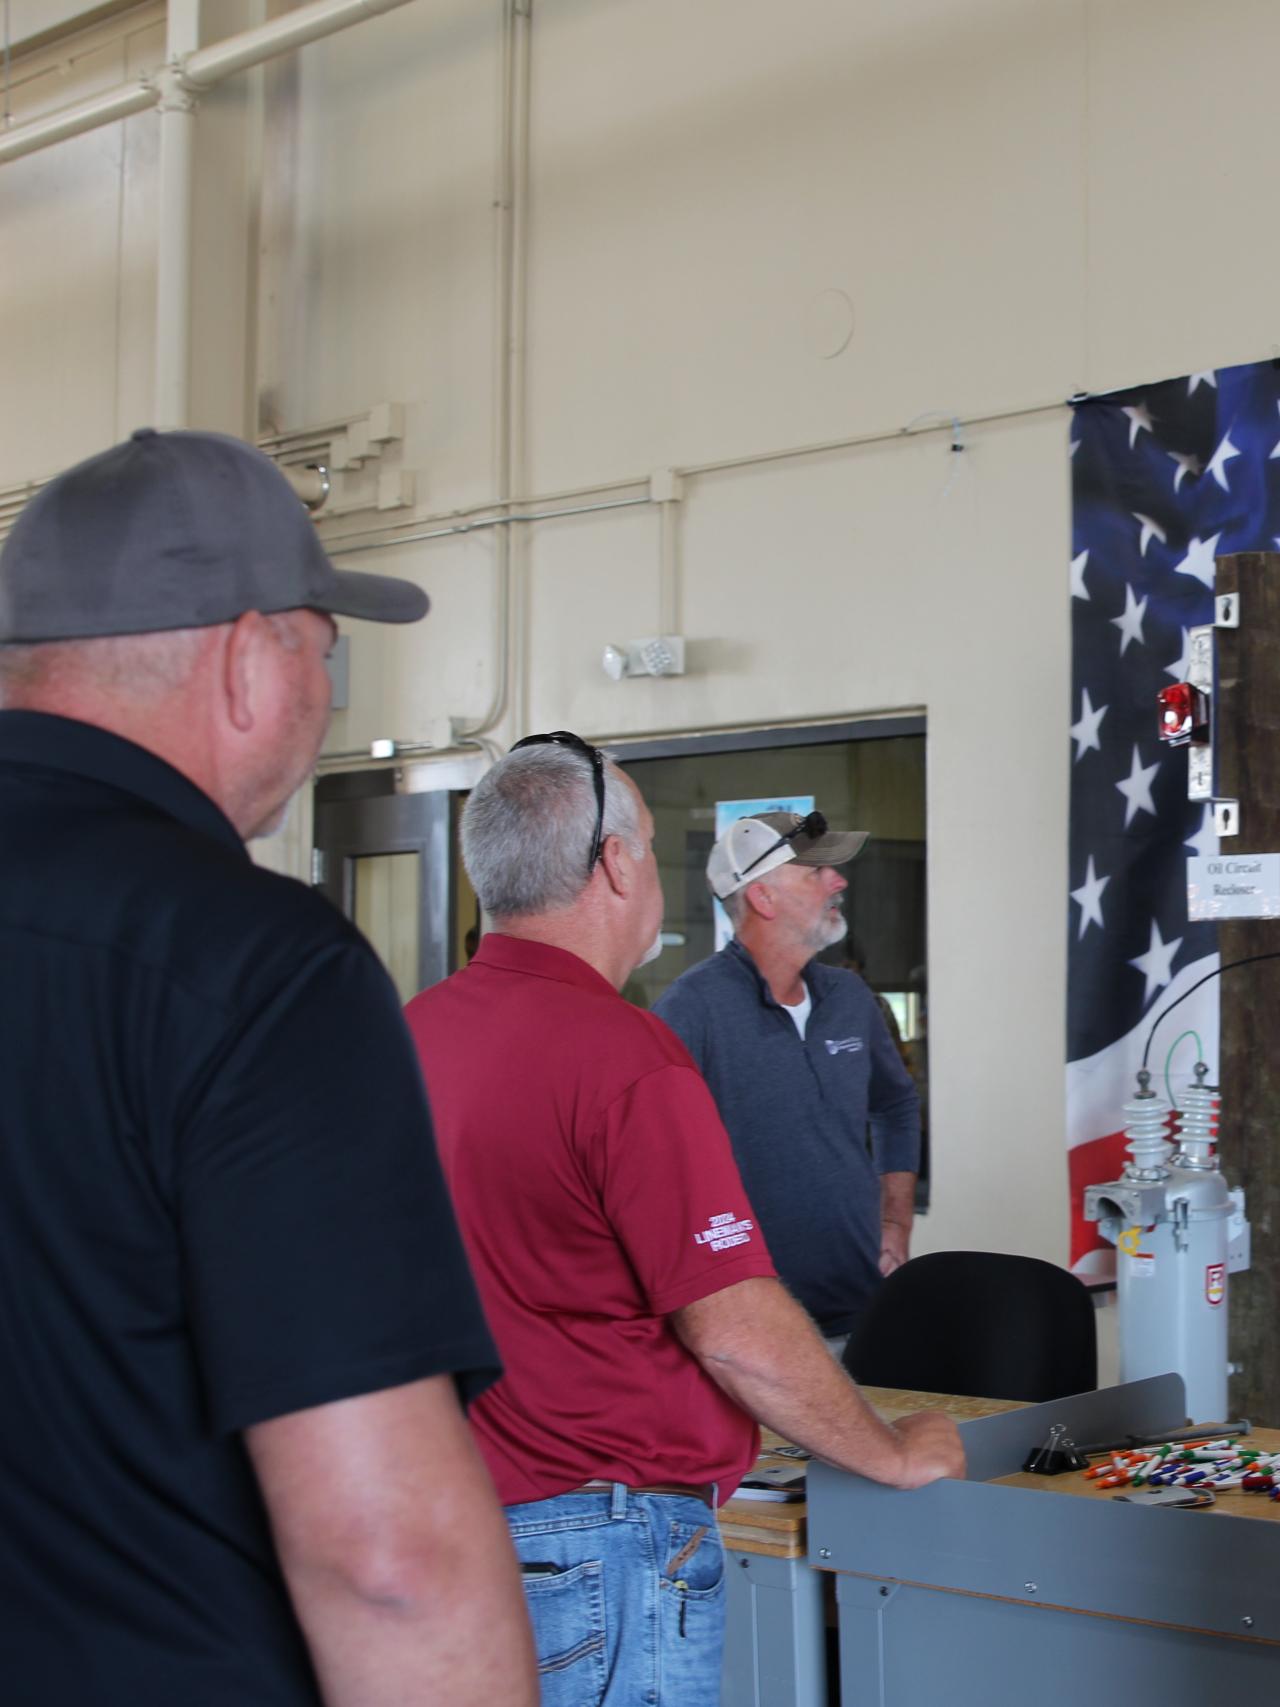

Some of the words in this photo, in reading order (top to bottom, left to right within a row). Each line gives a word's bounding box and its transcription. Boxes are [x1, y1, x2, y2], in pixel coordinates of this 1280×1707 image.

[1207, 862, 1222, 875] Oil
[1225, 861, 1262, 874] Circuit
[709, 1232, 751, 1252] RODEO
